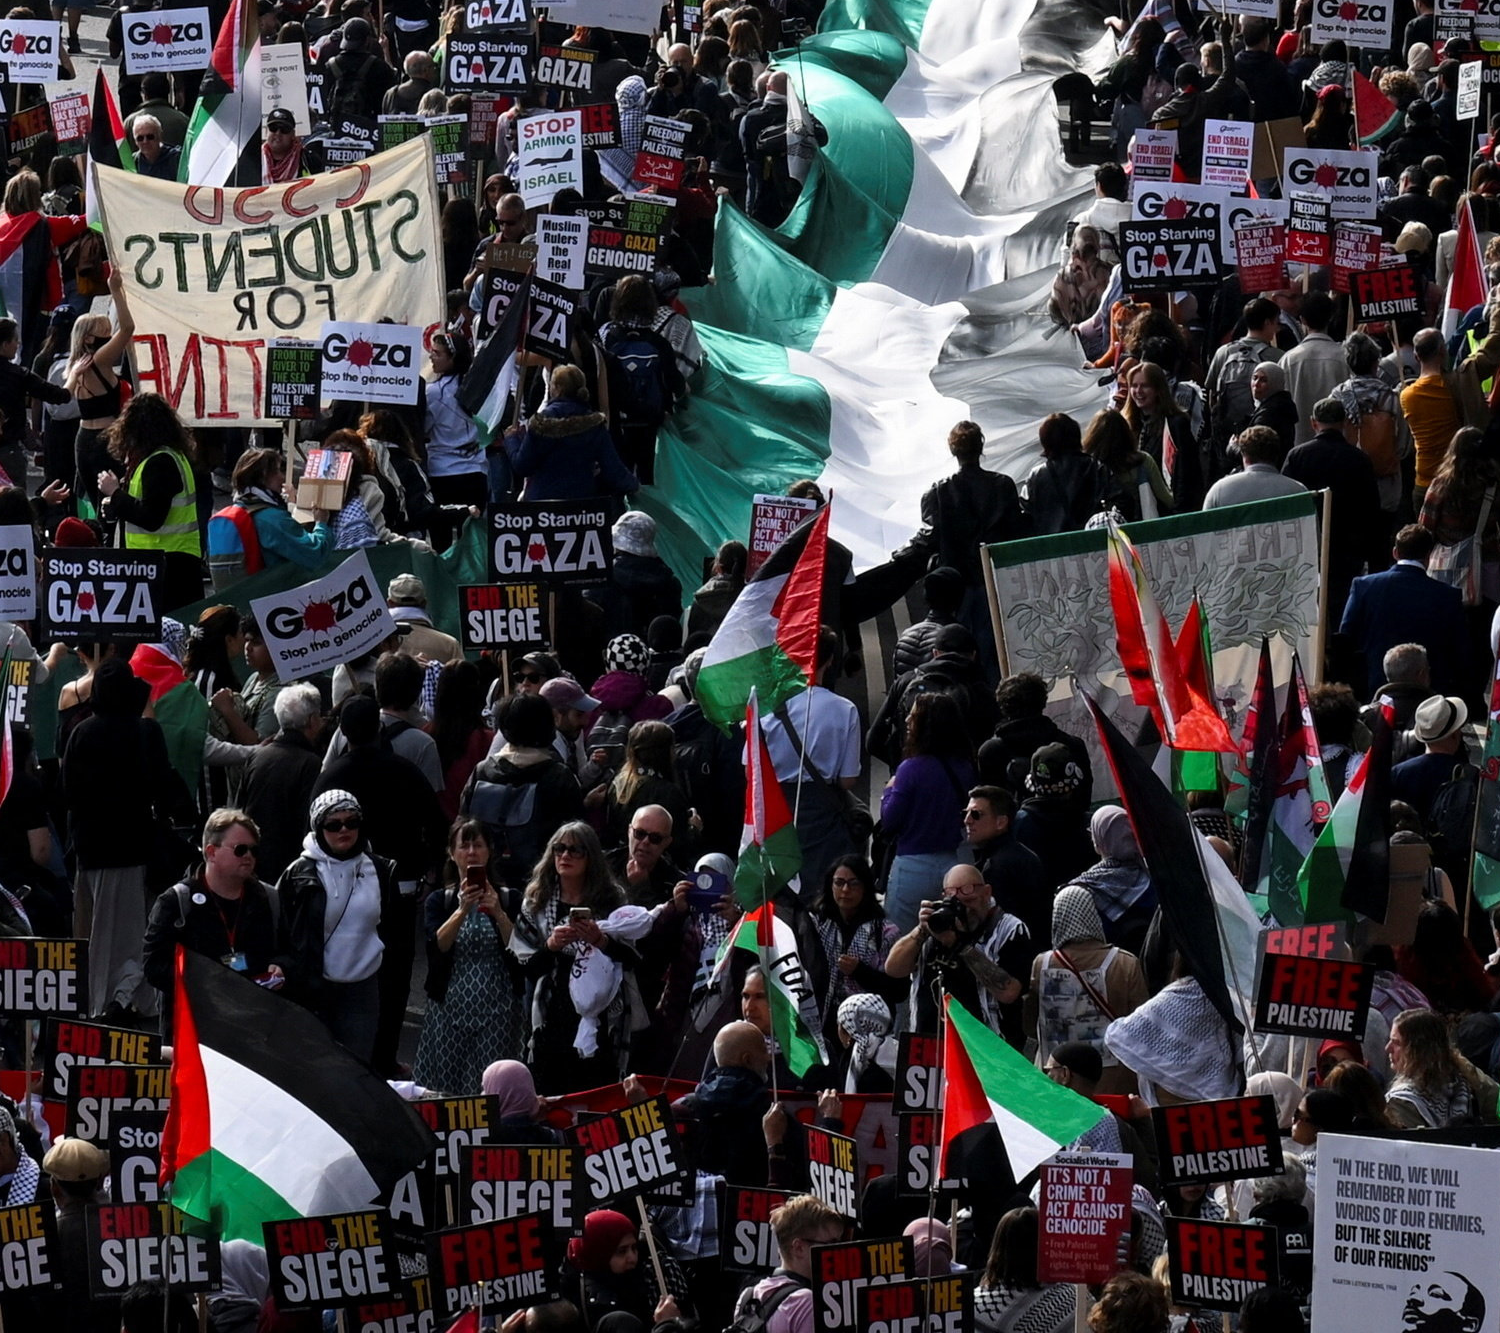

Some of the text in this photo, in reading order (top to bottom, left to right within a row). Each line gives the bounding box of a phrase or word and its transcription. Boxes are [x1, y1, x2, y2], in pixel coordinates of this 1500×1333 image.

[523, 114, 576, 139] STOP
[523, 136, 576, 152] ARMING
[524, 171, 578, 191] ISRAEL
[542, 221, 582, 235] Muslim
[543, 233, 578, 246] Rulers
[552, 246, 569, 257] the
[548, 258, 571, 270] Real
[271, 350, 318, 363] FROM THE
[271, 361, 314, 373] RIVER TO
[271, 372, 308, 383] THE SEA
[321, 370, 413, 389] Stop the genocide
[270, 381, 316, 394] PALESTINE
[270, 394, 304, 406] WILL BE
[270, 405, 293, 418] FREE
[466, 586, 540, 610] END THE
[467, 609, 542, 644] SIEGE
[1075, 1169, 1100, 1185] NOT
[1102, 1170, 1111, 1185] A
[1355, 1160, 1376, 1179] THE
[1378, 1163, 1404, 1183] END,
[1408, 1166, 1428, 1184] WE
[1431, 1168, 1459, 1187] WILL
[1047, 1185, 1106, 1200] CRIME TO
[1336, 1181, 1456, 1209] REMEMBER NOT THE
[1046, 1202, 1126, 1220] ACT AGAINST
[1336, 1201, 1485, 1235] WORDS OF OUR ENEMIES,
[1045, 1219, 1107, 1236] GENOCIDE
[1335, 1224, 1431, 1251] BUT THE SILENCE
[1334, 1245, 1348, 1263] OF
[1351, 1248, 1376, 1266] OUR
